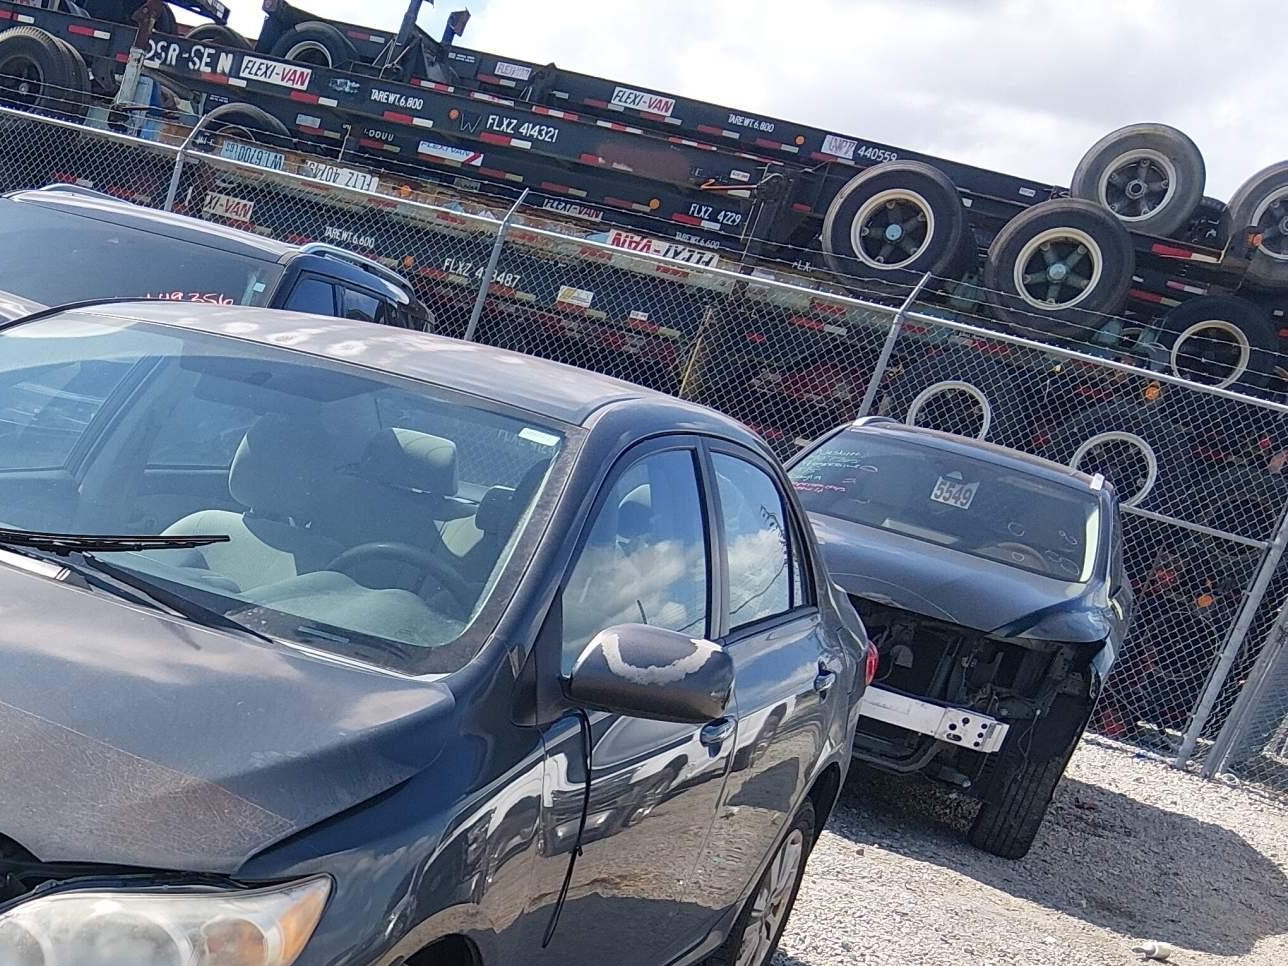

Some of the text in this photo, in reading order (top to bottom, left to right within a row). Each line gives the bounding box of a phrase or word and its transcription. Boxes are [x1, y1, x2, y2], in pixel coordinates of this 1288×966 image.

[242, 59, 310, 88] FLEXI-VAN
[614, 89, 673, 114] FLEXI-VAN
[485, 114, 560, 143] FLXZ 414321
[689, 203, 742, 226] FLXZ 4229
[443, 258, 521, 287] FLXZ 43487
[934, 481, 972, 506] 5549
